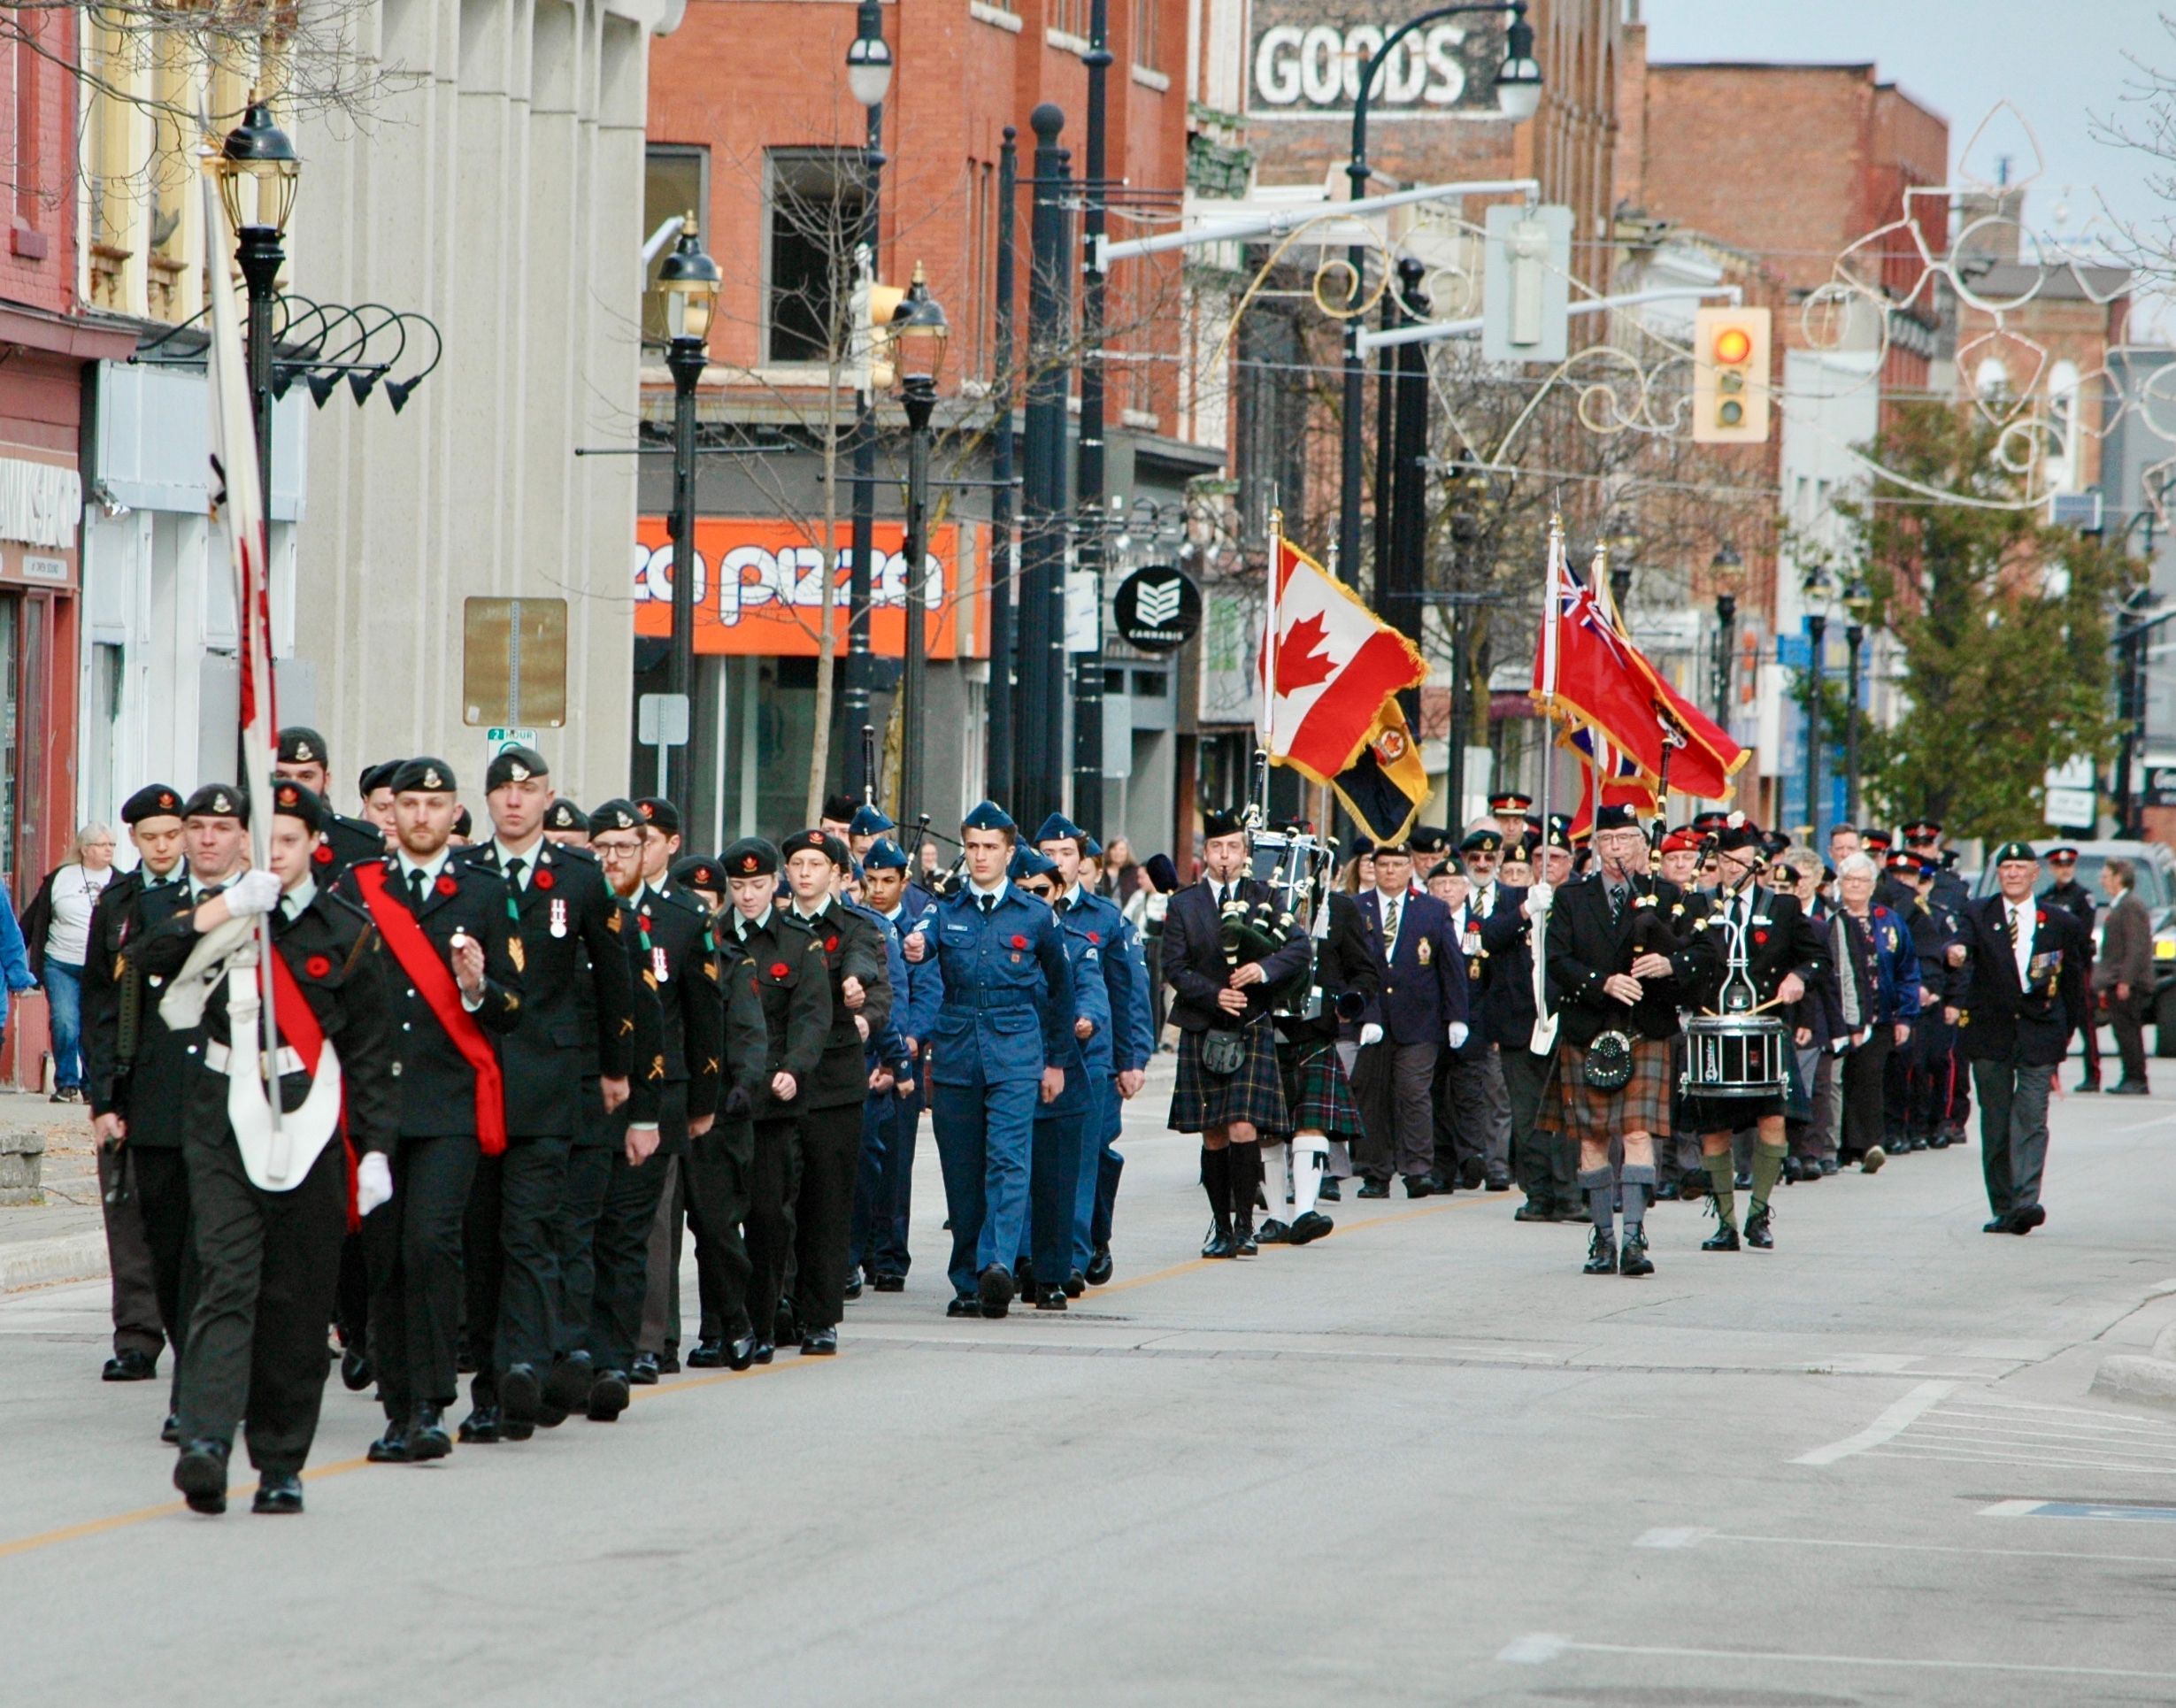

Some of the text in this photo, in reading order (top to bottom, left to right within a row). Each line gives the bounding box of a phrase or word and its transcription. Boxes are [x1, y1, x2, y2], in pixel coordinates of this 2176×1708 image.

[1256, 24, 1465, 104] GOODS
[719, 545, 943, 627] pizza
[1128, 629, 1183, 641] CANNABIS
[493, 729, 500, 740] 2
